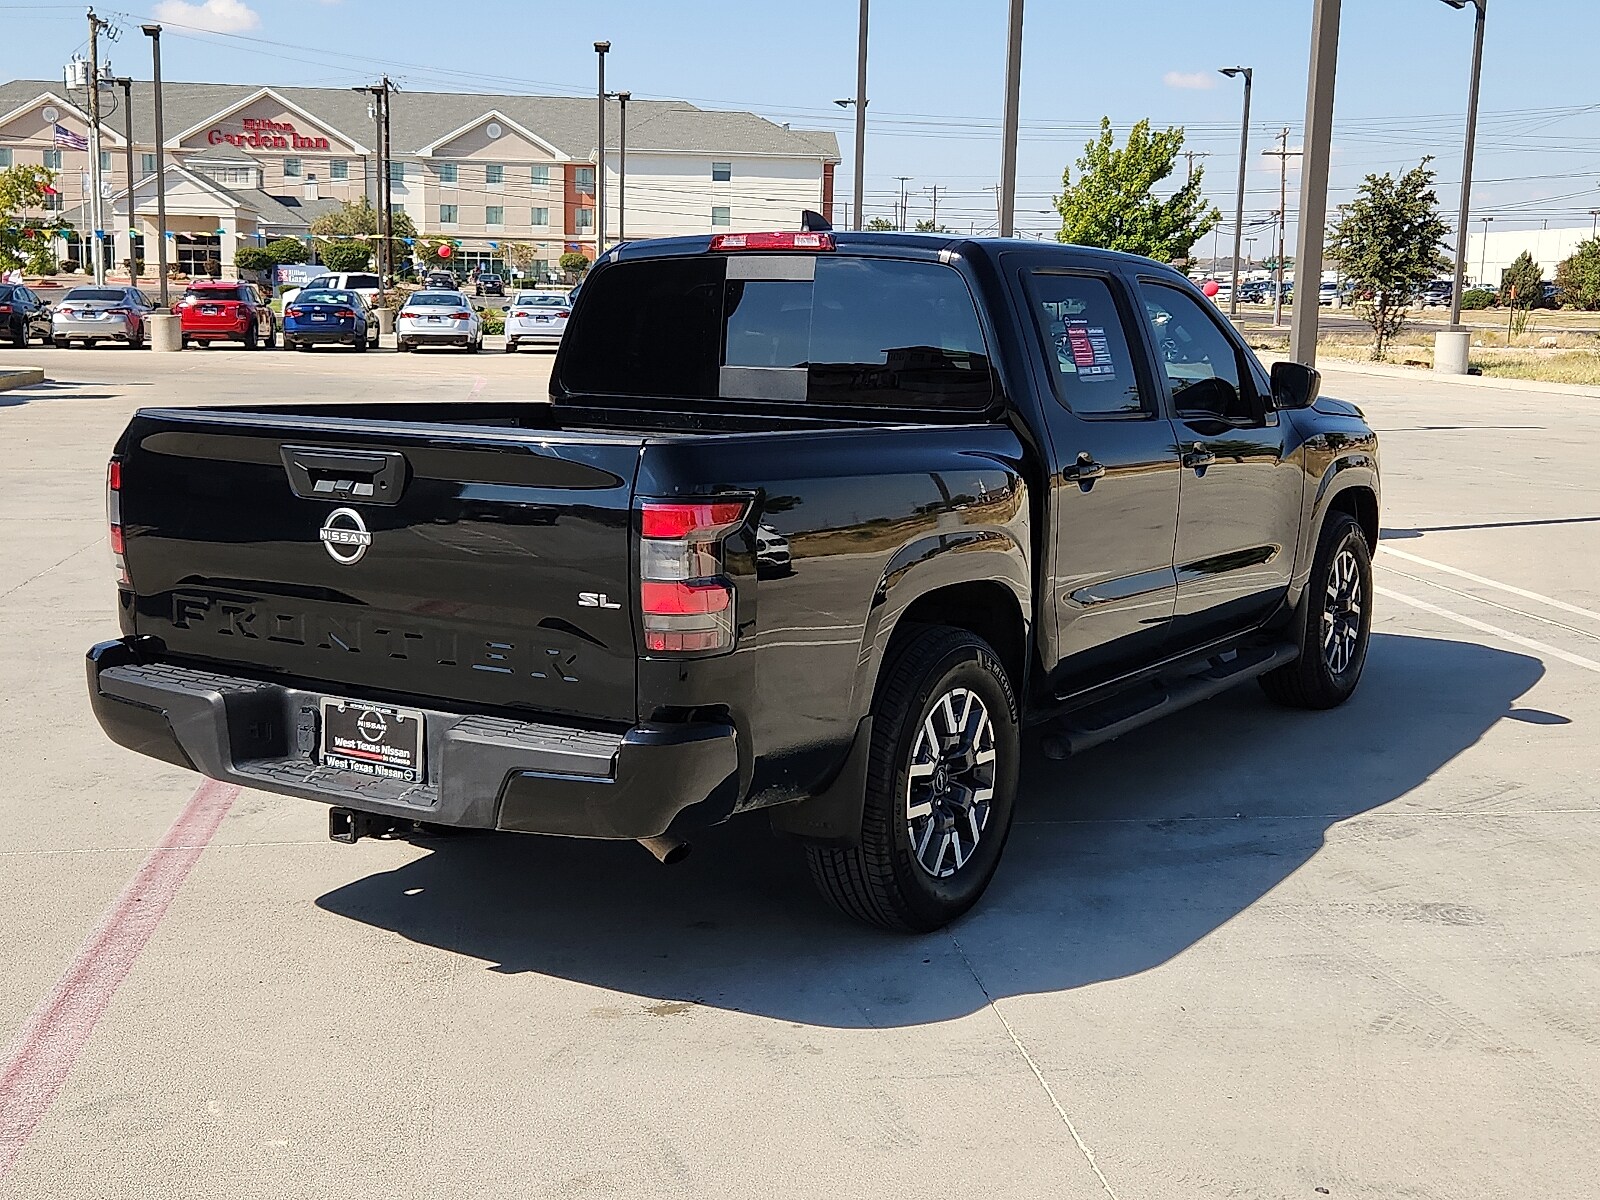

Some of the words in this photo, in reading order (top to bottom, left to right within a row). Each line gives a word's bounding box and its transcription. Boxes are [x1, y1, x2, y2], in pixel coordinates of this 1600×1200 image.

[242, 118, 293, 131] Hilton
[208, 130, 287, 148] Garden
[291, 132, 329, 148] Inn
[320, 530, 370, 544] NISSAN
[578, 592, 621, 609] SL
[172, 592, 581, 683] FRONTIER
[993, 663, 1018, 721] MICHELIN
[357, 720, 387, 731] NISSAN
[335, 737, 355, 748] West
[356, 741, 380, 753] Texas
[382, 745, 410, 758] Nissan
[327, 756, 348, 768] West
[349, 761, 373, 773] Texas
[375, 765, 403, 778] Nissan
